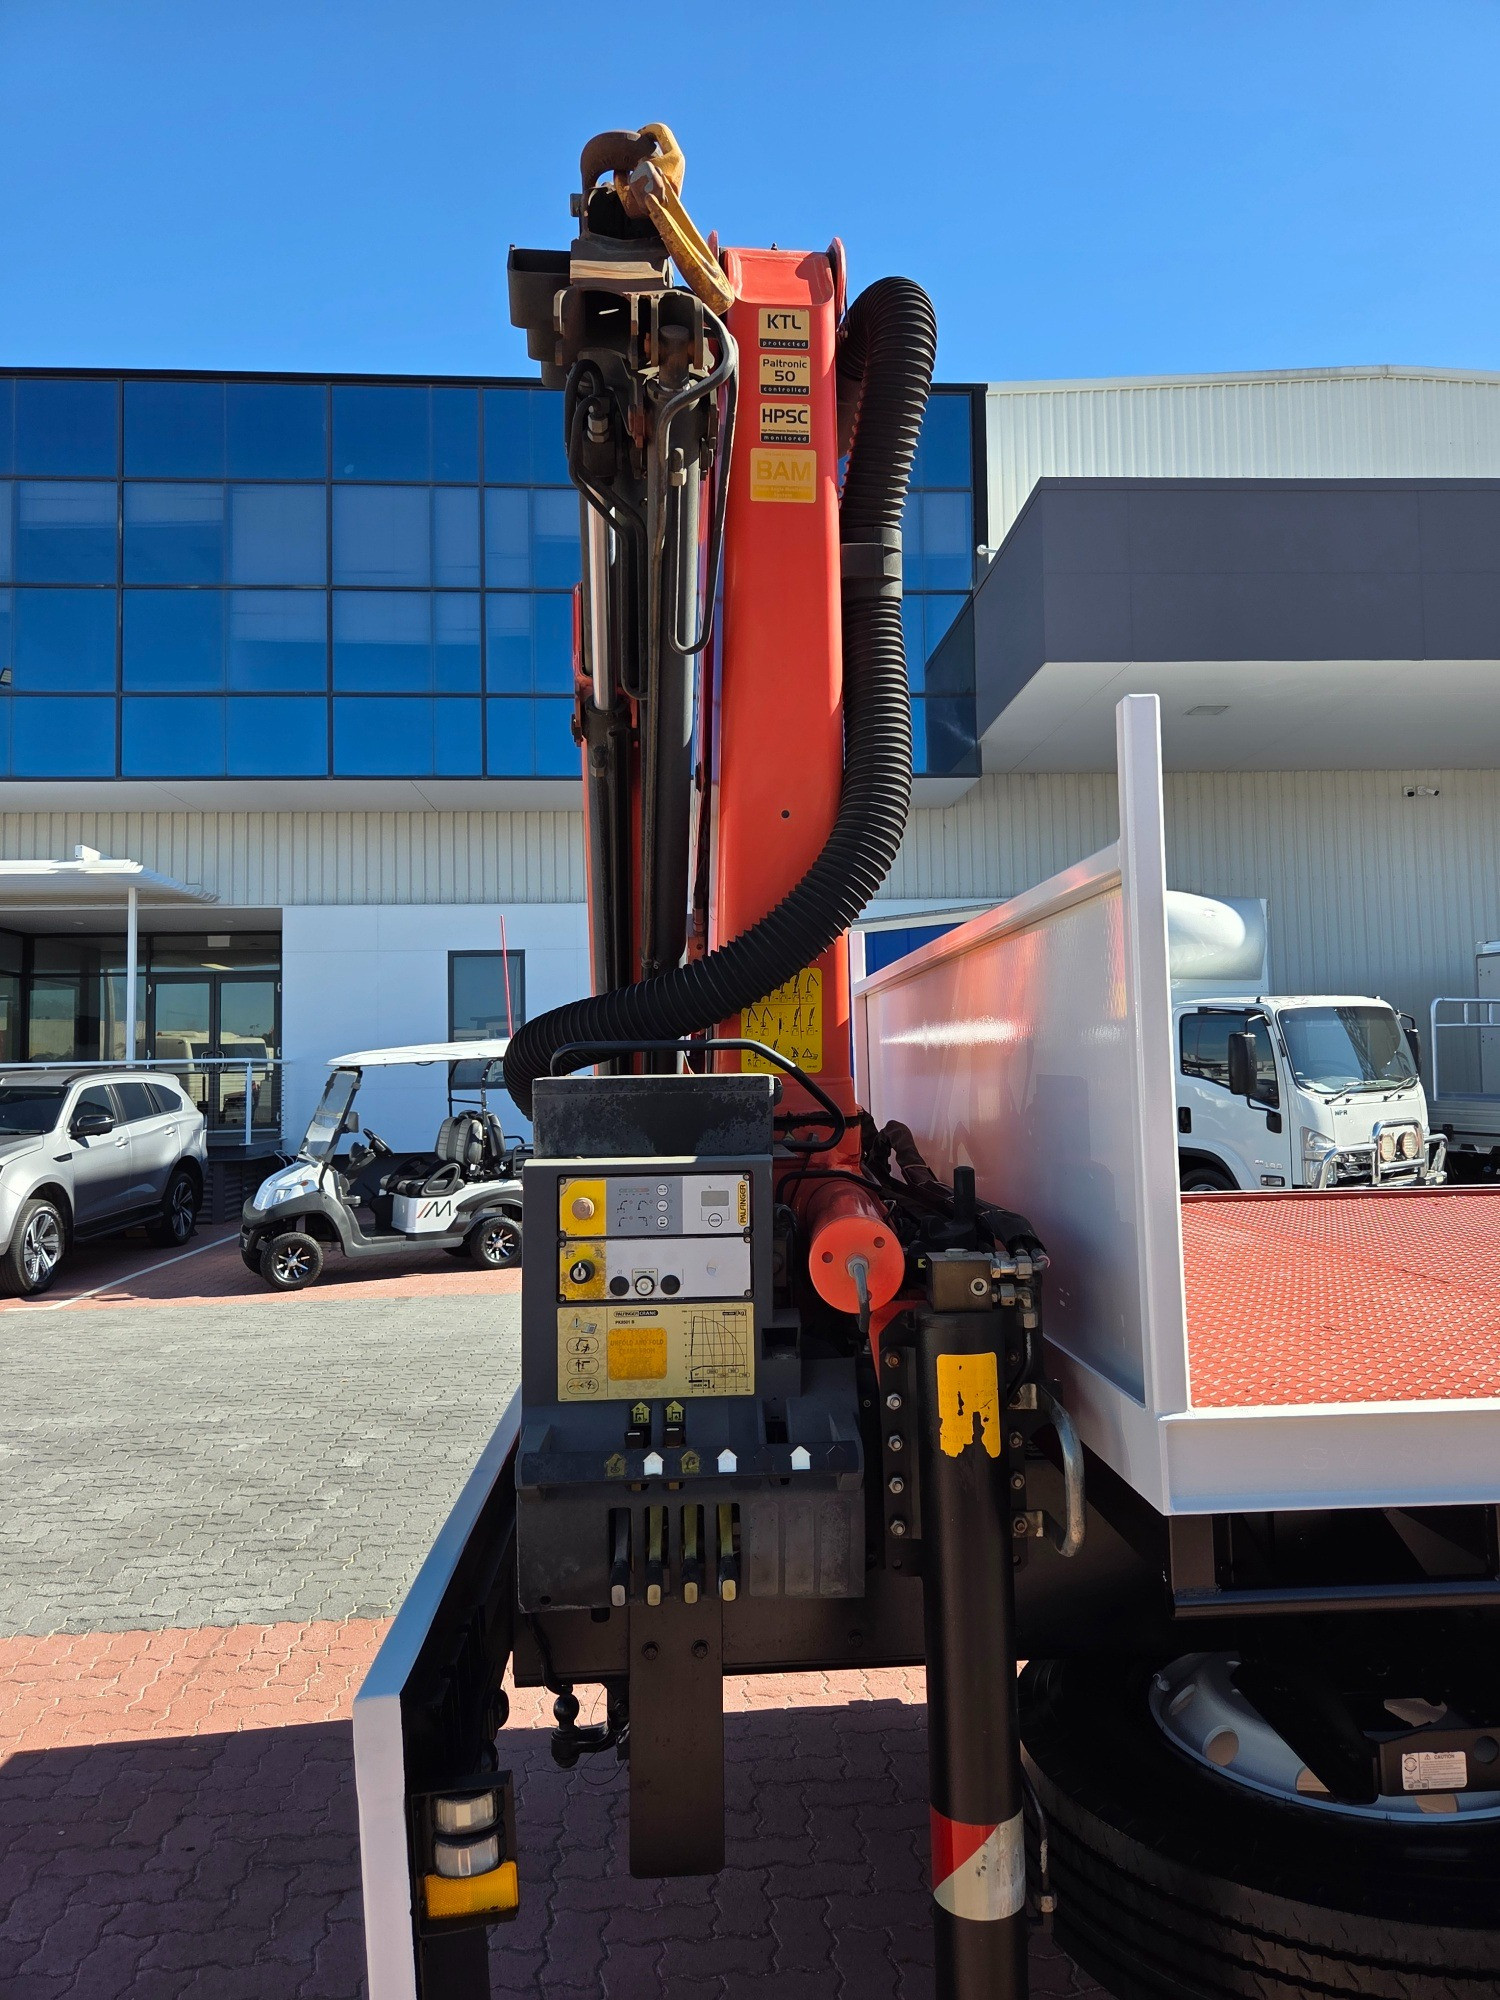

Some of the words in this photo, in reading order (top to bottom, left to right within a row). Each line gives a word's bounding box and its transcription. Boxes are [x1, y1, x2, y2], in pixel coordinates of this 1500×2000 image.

[767, 314, 801, 329] KTL
[762, 359, 807, 368] Paltronic
[774, 370, 796, 382] 50
[762, 408, 808, 424] HPSC
[757, 461, 811, 481] BAM
